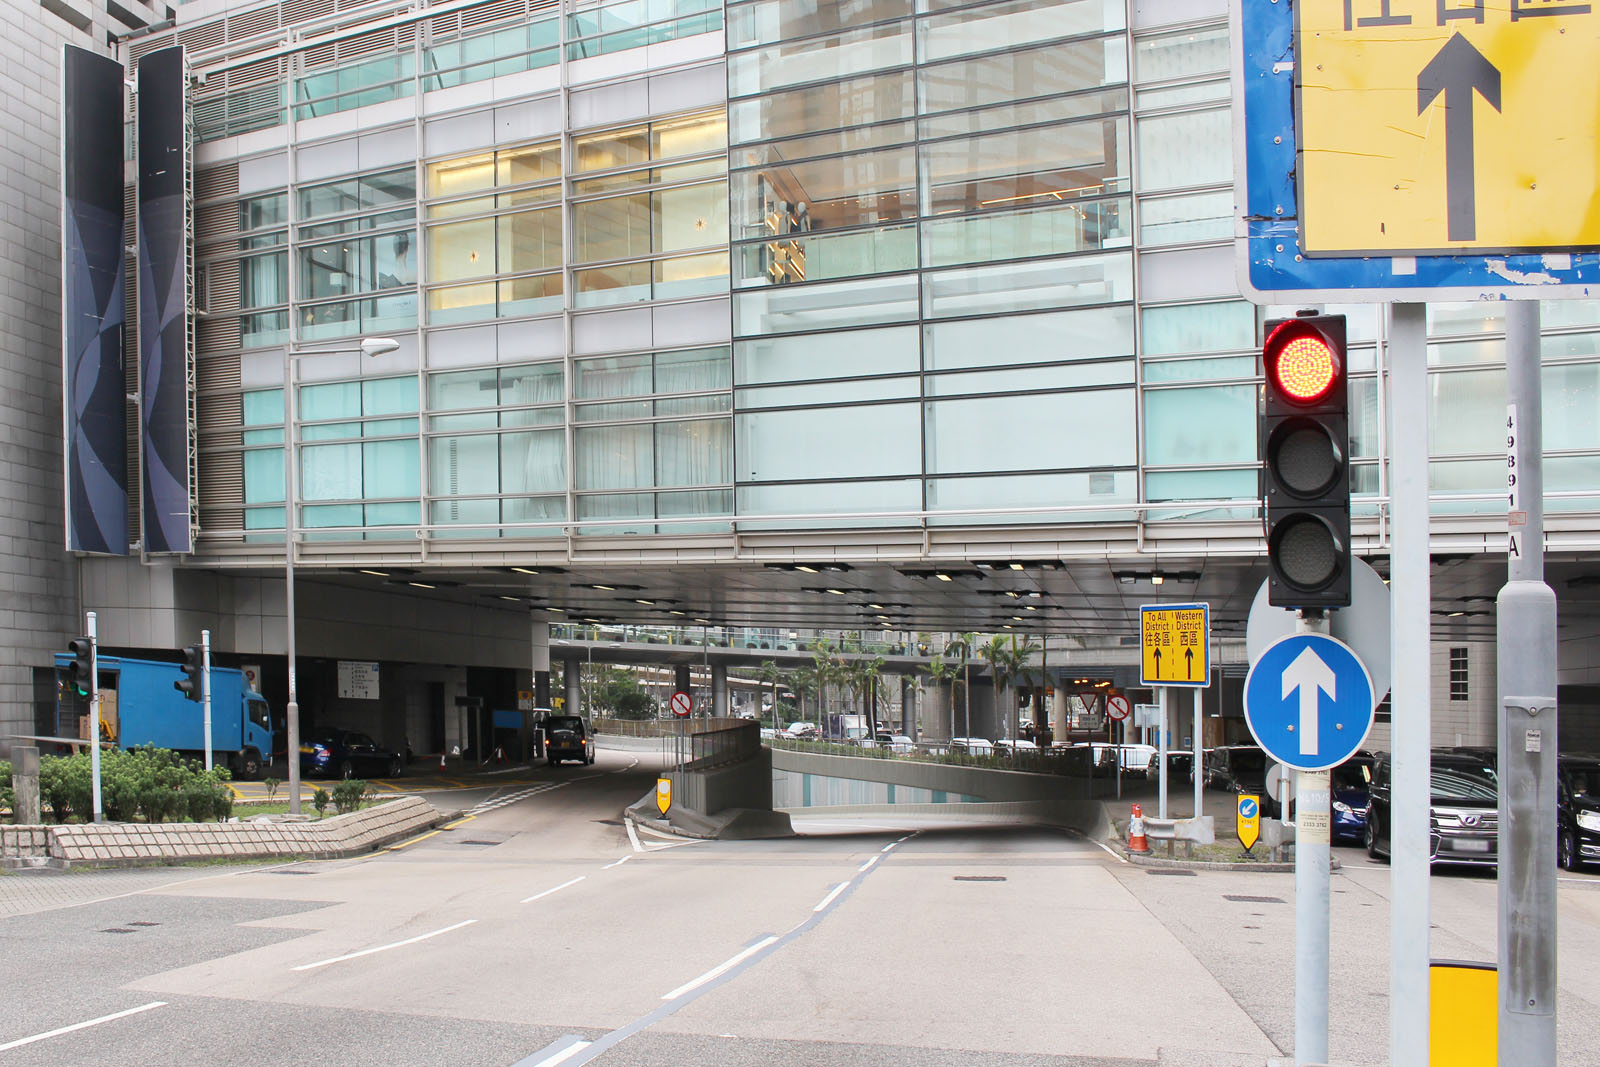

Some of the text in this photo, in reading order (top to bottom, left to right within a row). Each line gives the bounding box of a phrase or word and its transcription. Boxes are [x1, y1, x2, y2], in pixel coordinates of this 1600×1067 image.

[1507, 416, 1517, 507] 49891
[1508, 535, 1520, 558] A
[1148, 611, 1167, 621] To All
[1175, 611, 1203, 621] Western
[1145, 622, 1170, 631] District
[1176, 621, 1202, 631] District
[1145, 631, 1171, 647] 往各區
[1180, 630, 1198, 646] 西區
